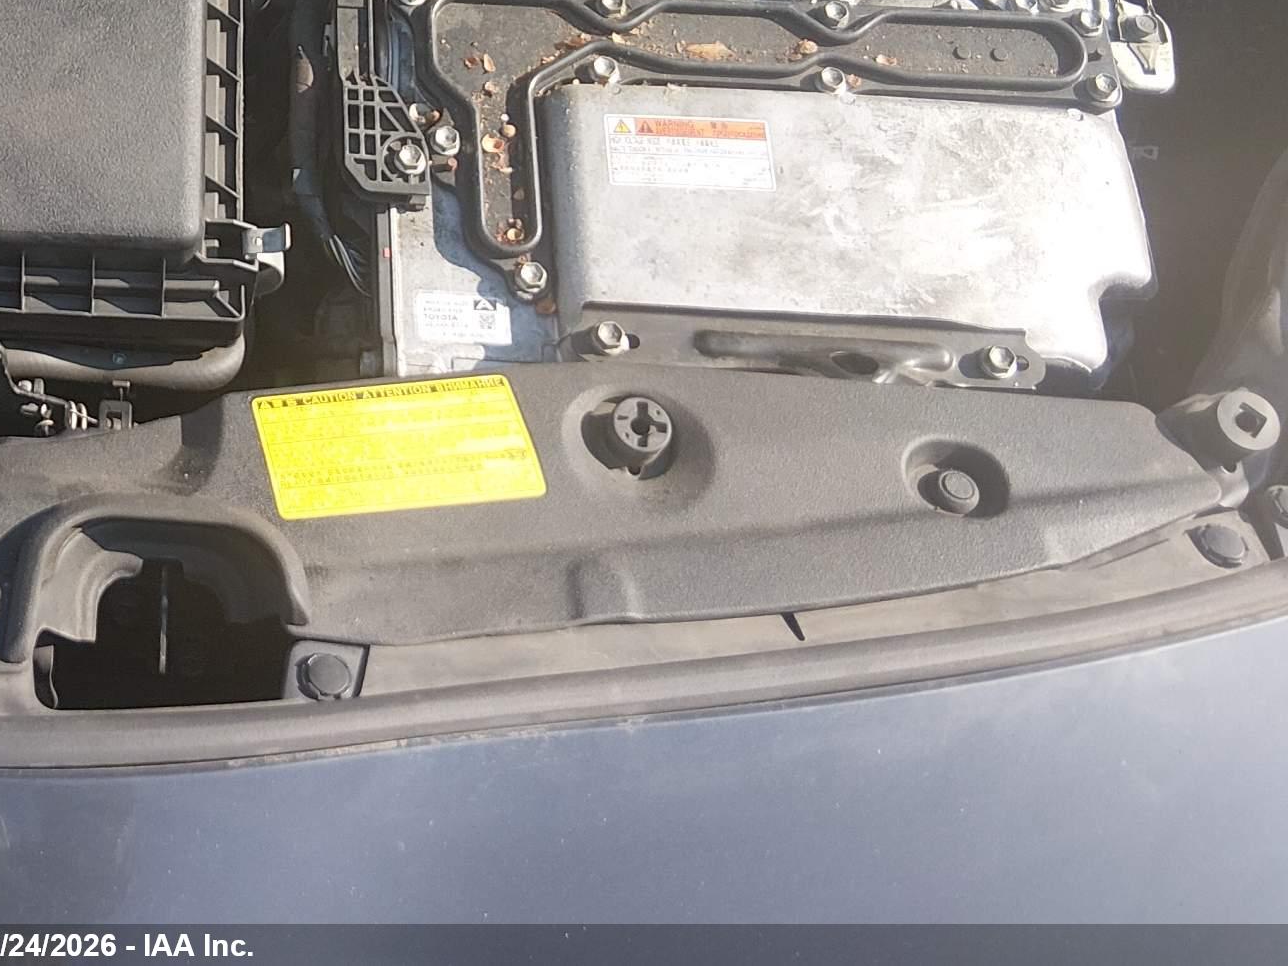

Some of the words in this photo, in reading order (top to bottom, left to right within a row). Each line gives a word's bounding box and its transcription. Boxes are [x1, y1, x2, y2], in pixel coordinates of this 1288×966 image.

[423, 313, 459, 322] TOYOTA
[302, 391, 356, 405] CAUTION
[363, 384, 430, 399] ATTENTION
[437, 378, 503, 392] ВНИМАНИЕ
